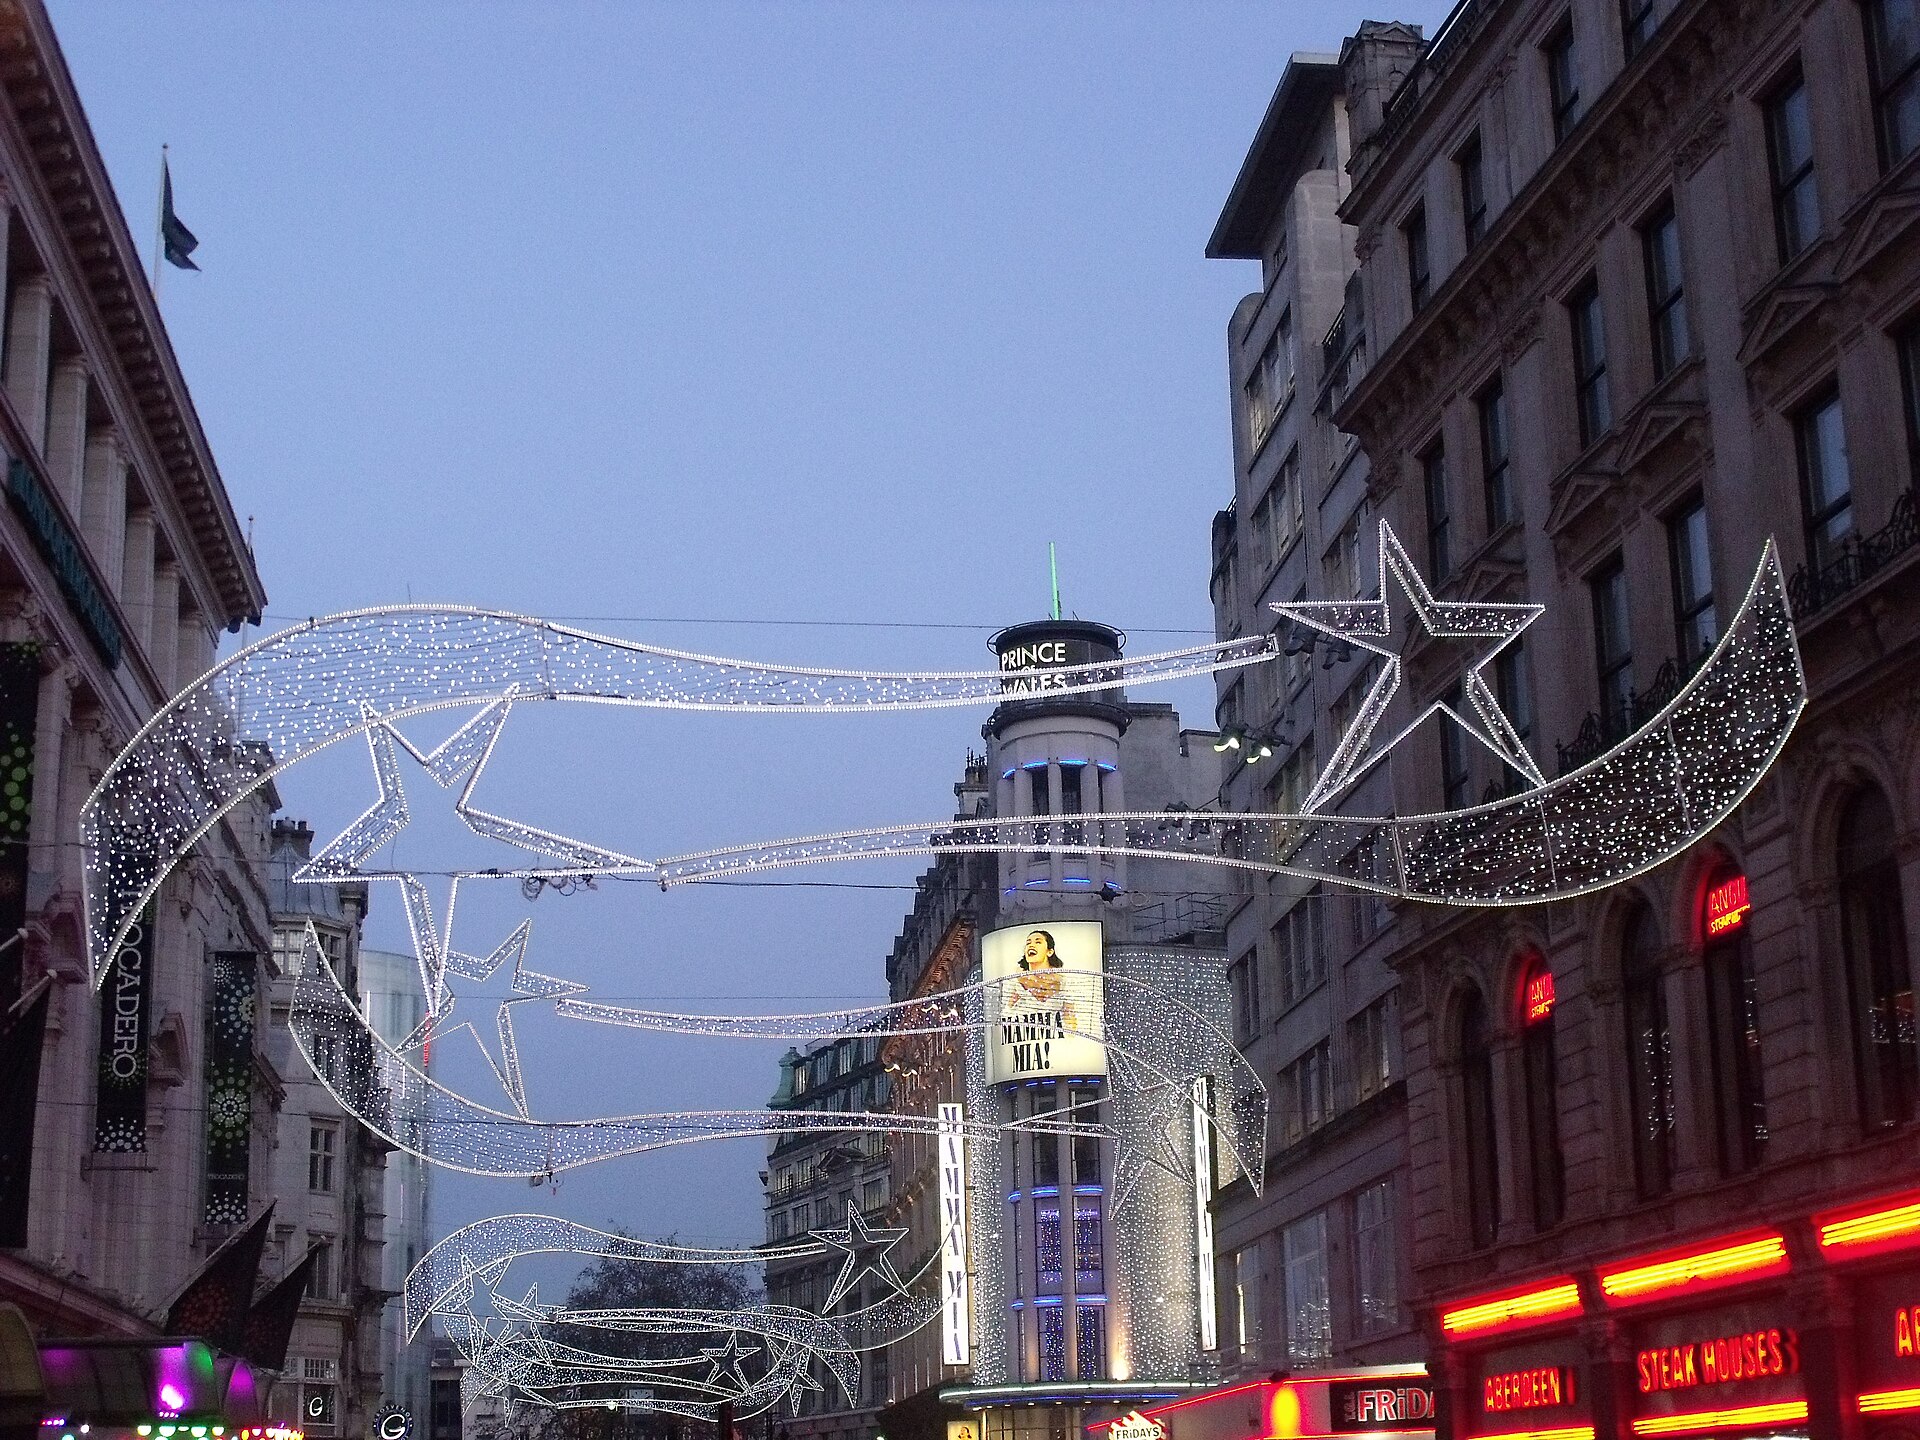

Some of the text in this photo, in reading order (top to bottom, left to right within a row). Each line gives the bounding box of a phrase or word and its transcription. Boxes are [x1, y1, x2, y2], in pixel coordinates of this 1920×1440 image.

[1002, 643, 1066, 674] PRINCE
[1001, 1012, 1064, 1045] MAMMA
[1013, 1042, 1049, 1073] MIA!
[1638, 1329, 1783, 1392] STEAK HOUSES
[1485, 1367, 1561, 1412] ABERDEEN
[309, 1397, 323, 1417] G
[381, 1413, 406, 1440] G
